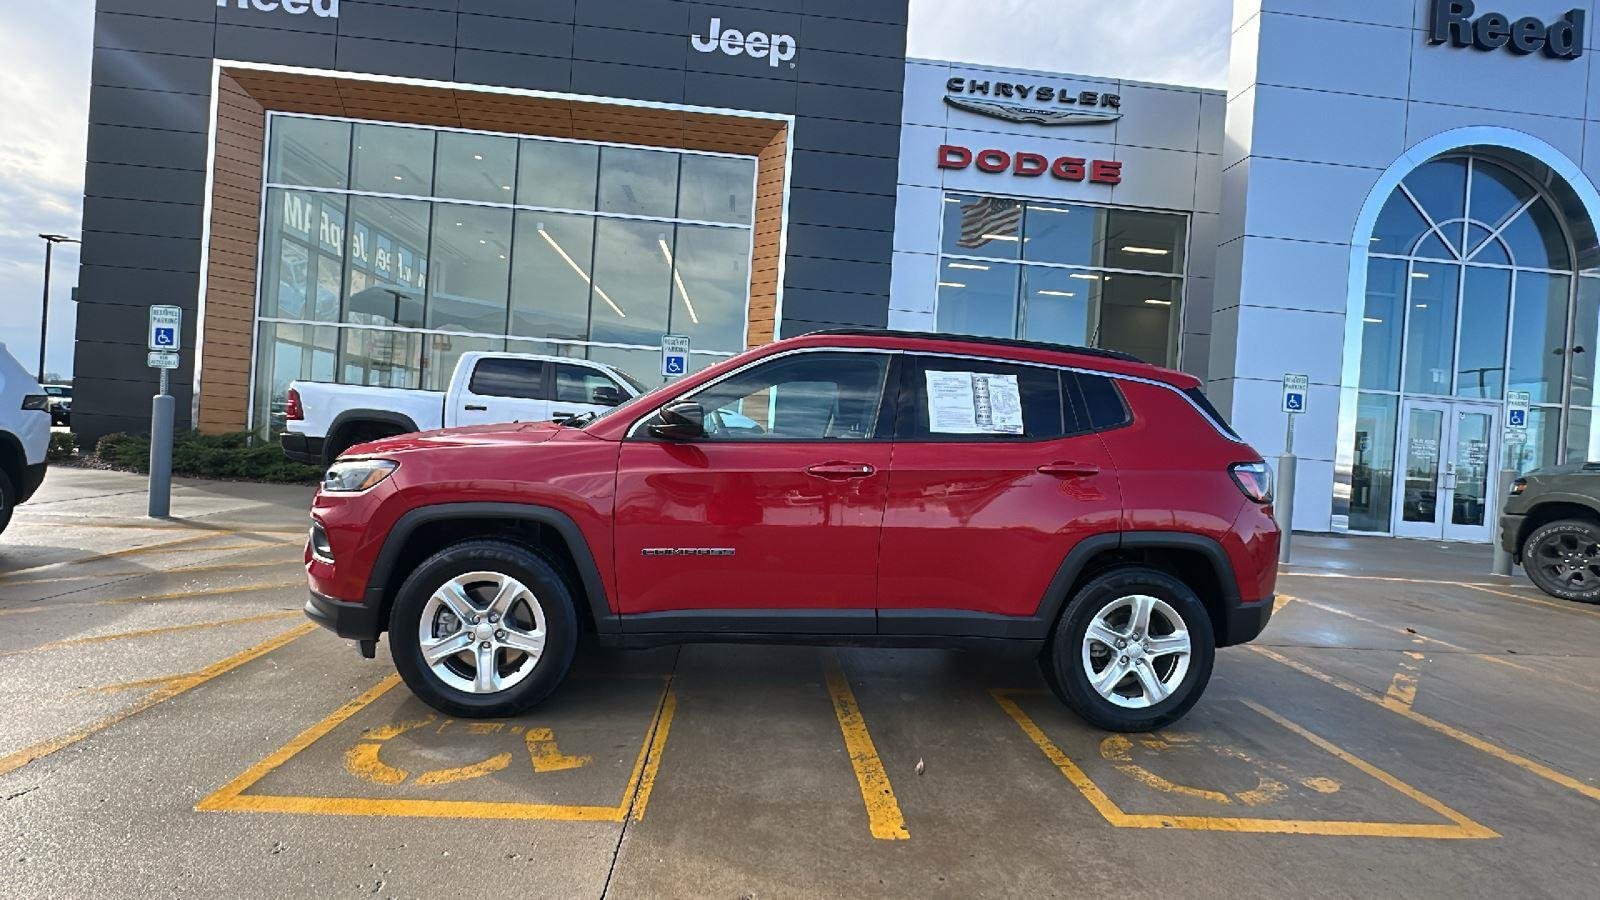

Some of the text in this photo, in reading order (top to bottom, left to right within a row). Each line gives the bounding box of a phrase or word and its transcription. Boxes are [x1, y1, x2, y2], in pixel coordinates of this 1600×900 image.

[216, 0, 339, 18] eed
[691, 17, 797, 67] Jeep
[1427, 0, 1586, 60] Reed
[946, 77, 1121, 107] CHRYSLER
[938, 144, 1122, 185] DODGE
[641, 547, 736, 556] COMPASS
